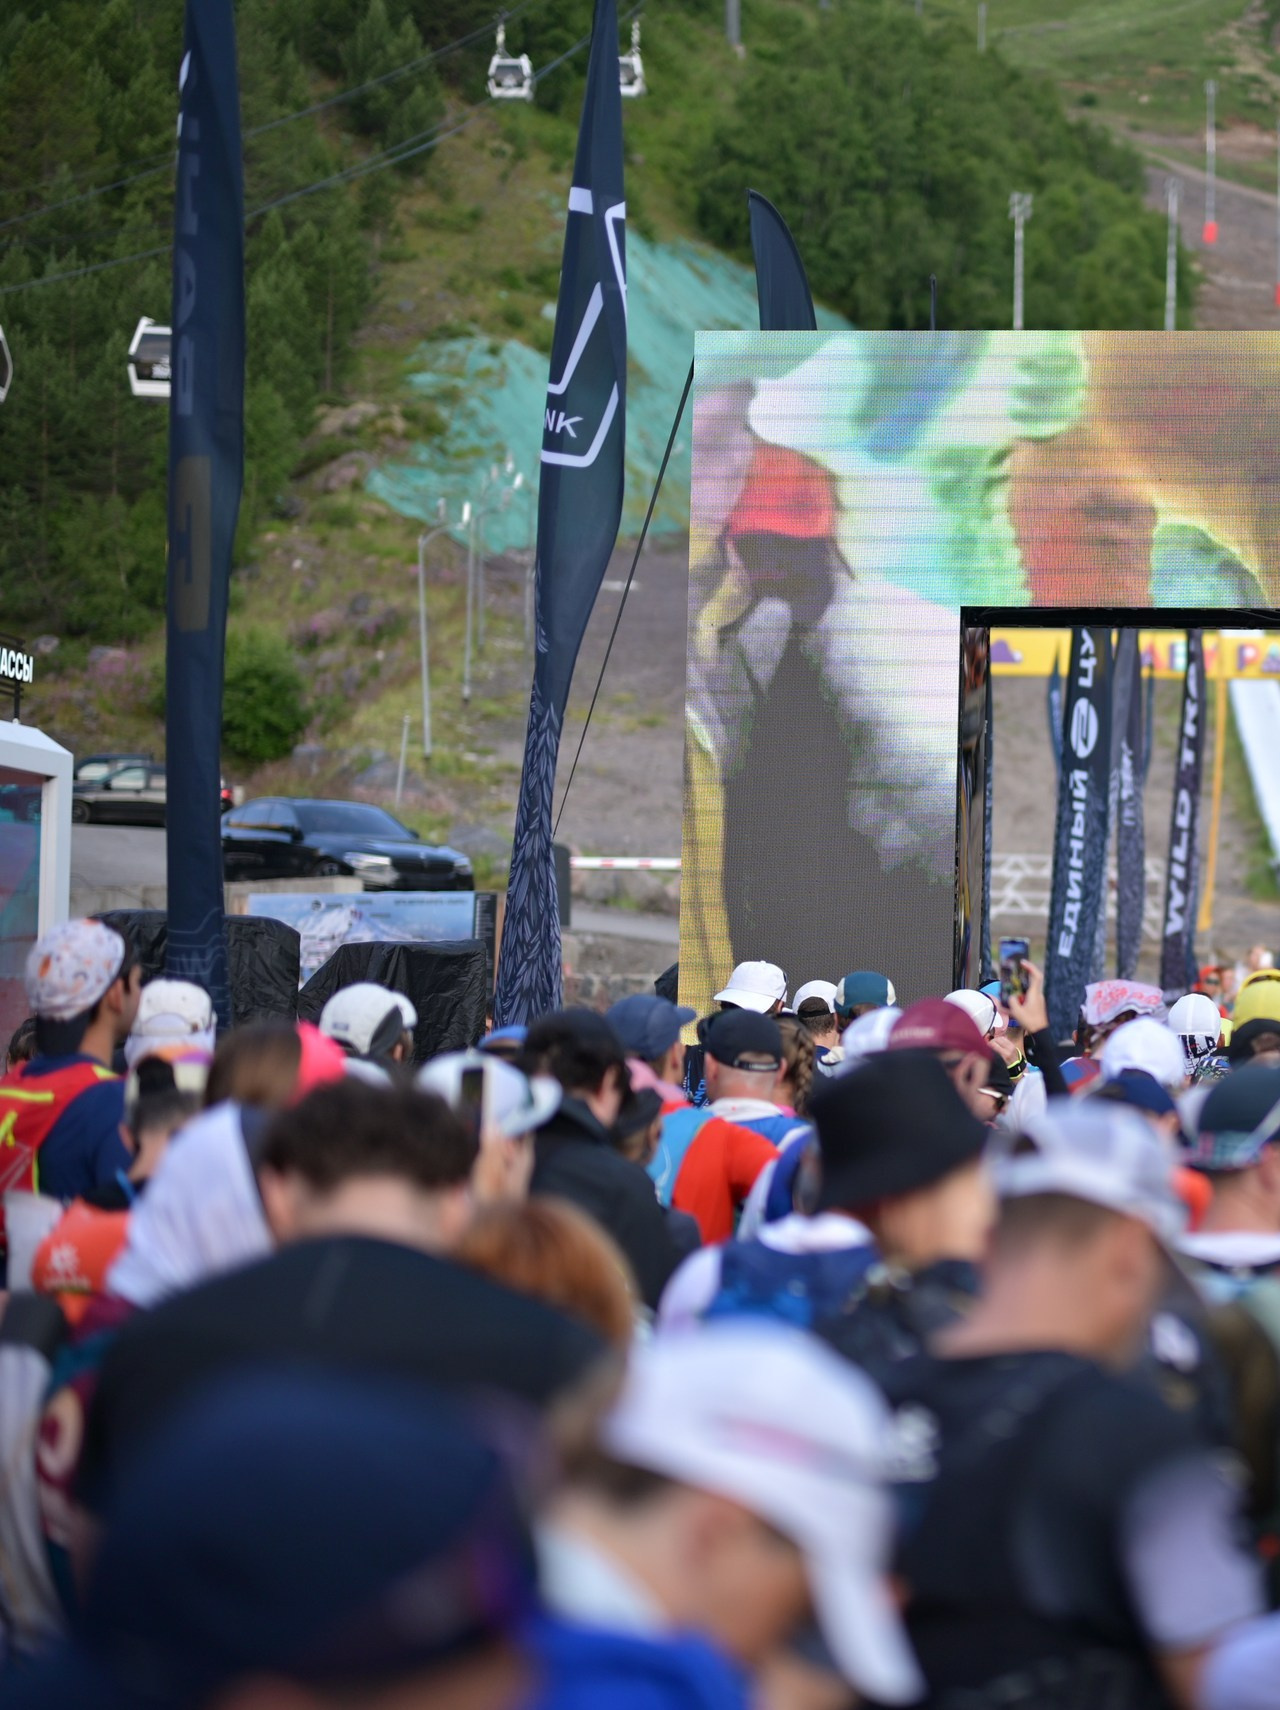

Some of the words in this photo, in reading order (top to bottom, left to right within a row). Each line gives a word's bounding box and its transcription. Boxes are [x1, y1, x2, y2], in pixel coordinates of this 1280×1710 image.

[0, 646, 34, 683] АССЫ
[1058, 769, 1088, 958] ЕДИНЫЙ
[1165, 788, 1191, 936] WILD
